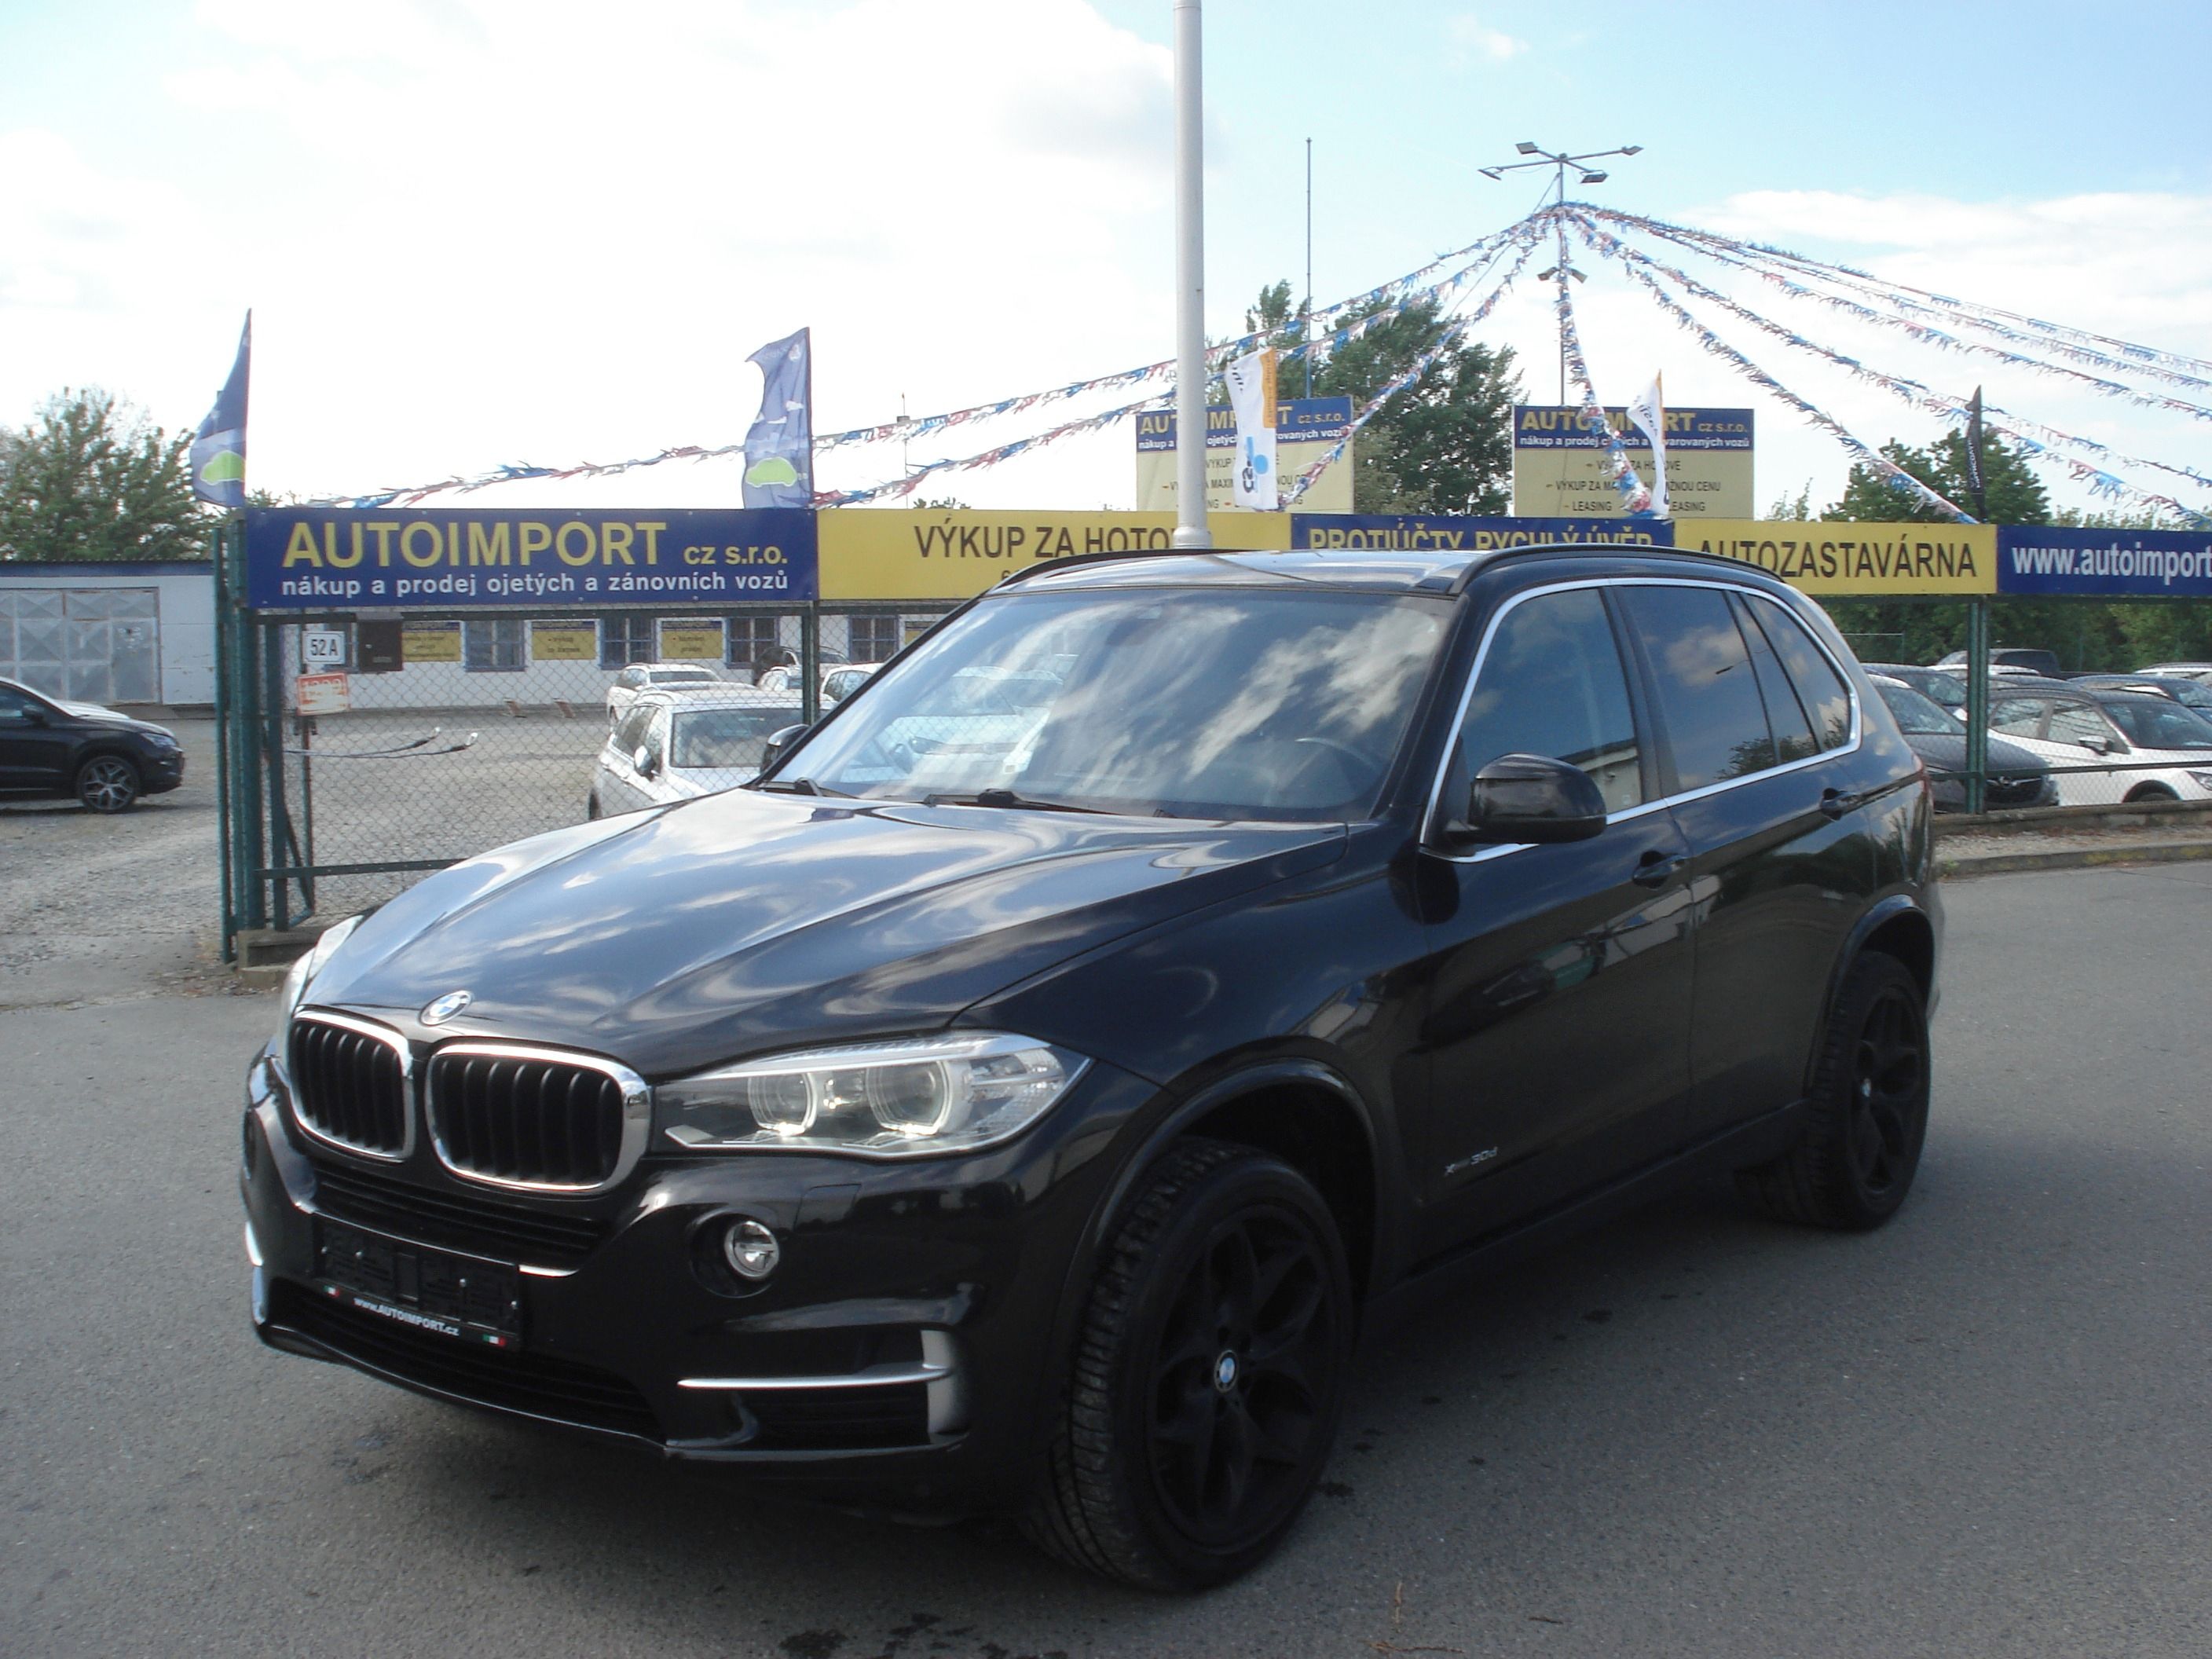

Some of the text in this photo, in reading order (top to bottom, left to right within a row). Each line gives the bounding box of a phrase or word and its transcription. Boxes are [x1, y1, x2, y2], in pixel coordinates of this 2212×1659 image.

[1520, 435, 1553, 447] nákup
[1565, 436, 1599, 447] prodej
[1588, 481, 1601, 491] ZA
[1697, 481, 1721, 491] CENU
[1573, 500, 1612, 511] LEASING
[282, 521, 789, 568] AUTOIMPORT cz s.r.o.
[914, 517, 1025, 558] VÝKUP
[1035, 526, 1075, 558] ZA
[282, 570, 789, 599] nákup a prodej ojetých a zánovních vozů
